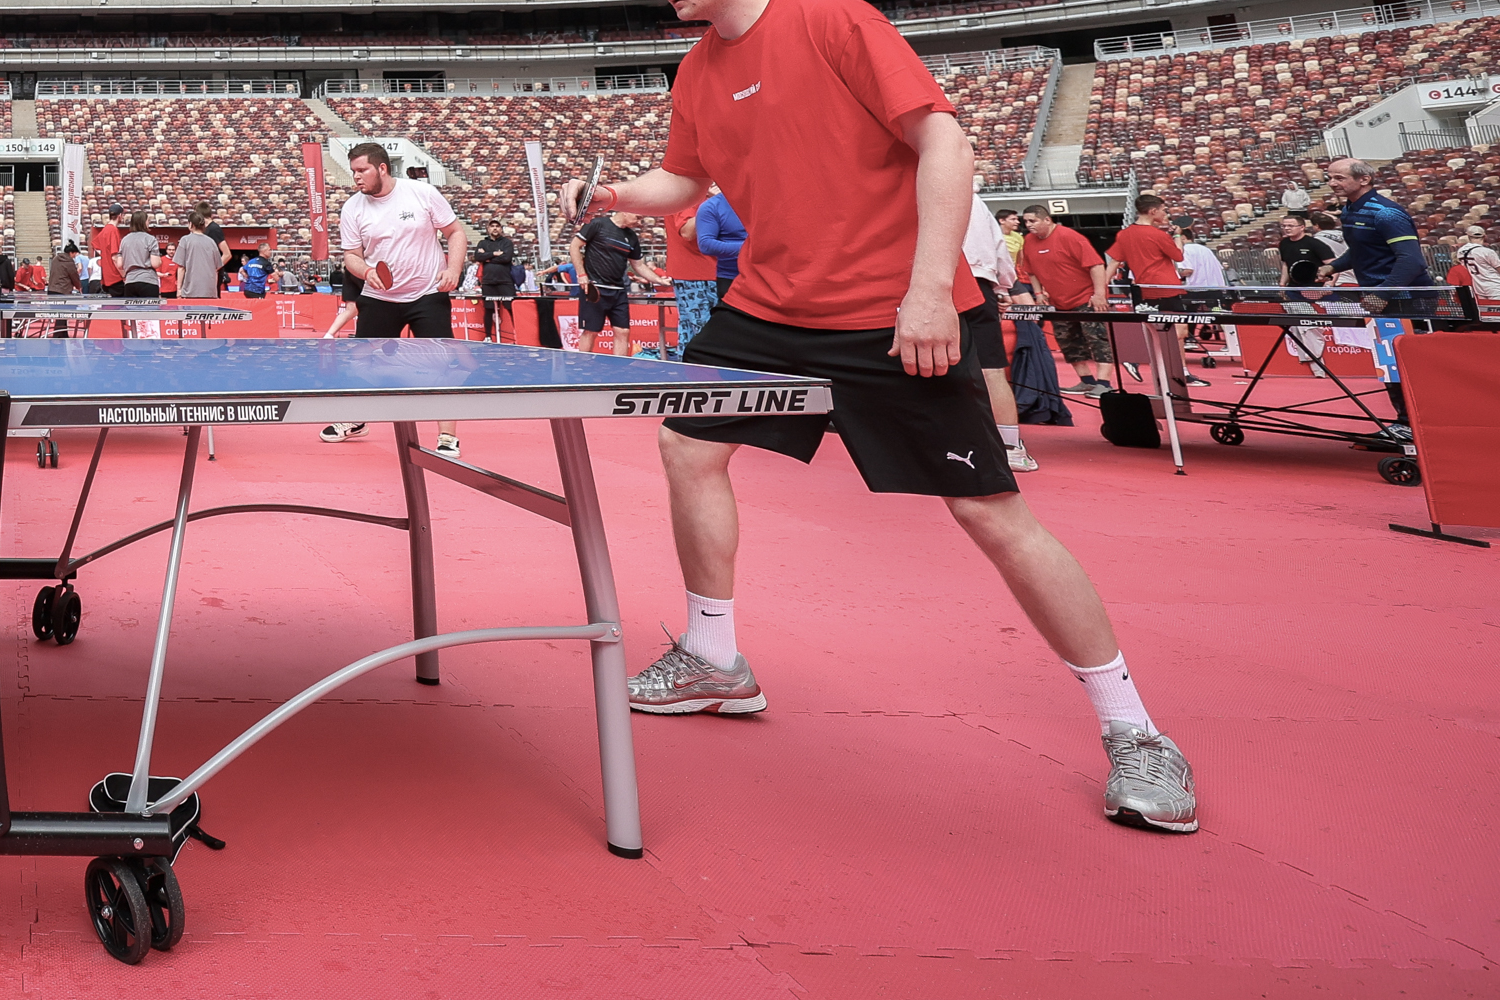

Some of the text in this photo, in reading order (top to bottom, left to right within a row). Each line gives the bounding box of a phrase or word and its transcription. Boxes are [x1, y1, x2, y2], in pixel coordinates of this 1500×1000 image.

[1443, 86, 1477, 99] 144
[5, 143, 55, 152] 150 149
[67, 170, 75, 216] МОСКОВСКИЙ
[1147, 314, 1187, 323] START
[612, 389, 809, 415] START LINE
[98, 404, 280, 423] НАСТОЛЬНЫЙ ТЕННИС В ШКОЛЕ
